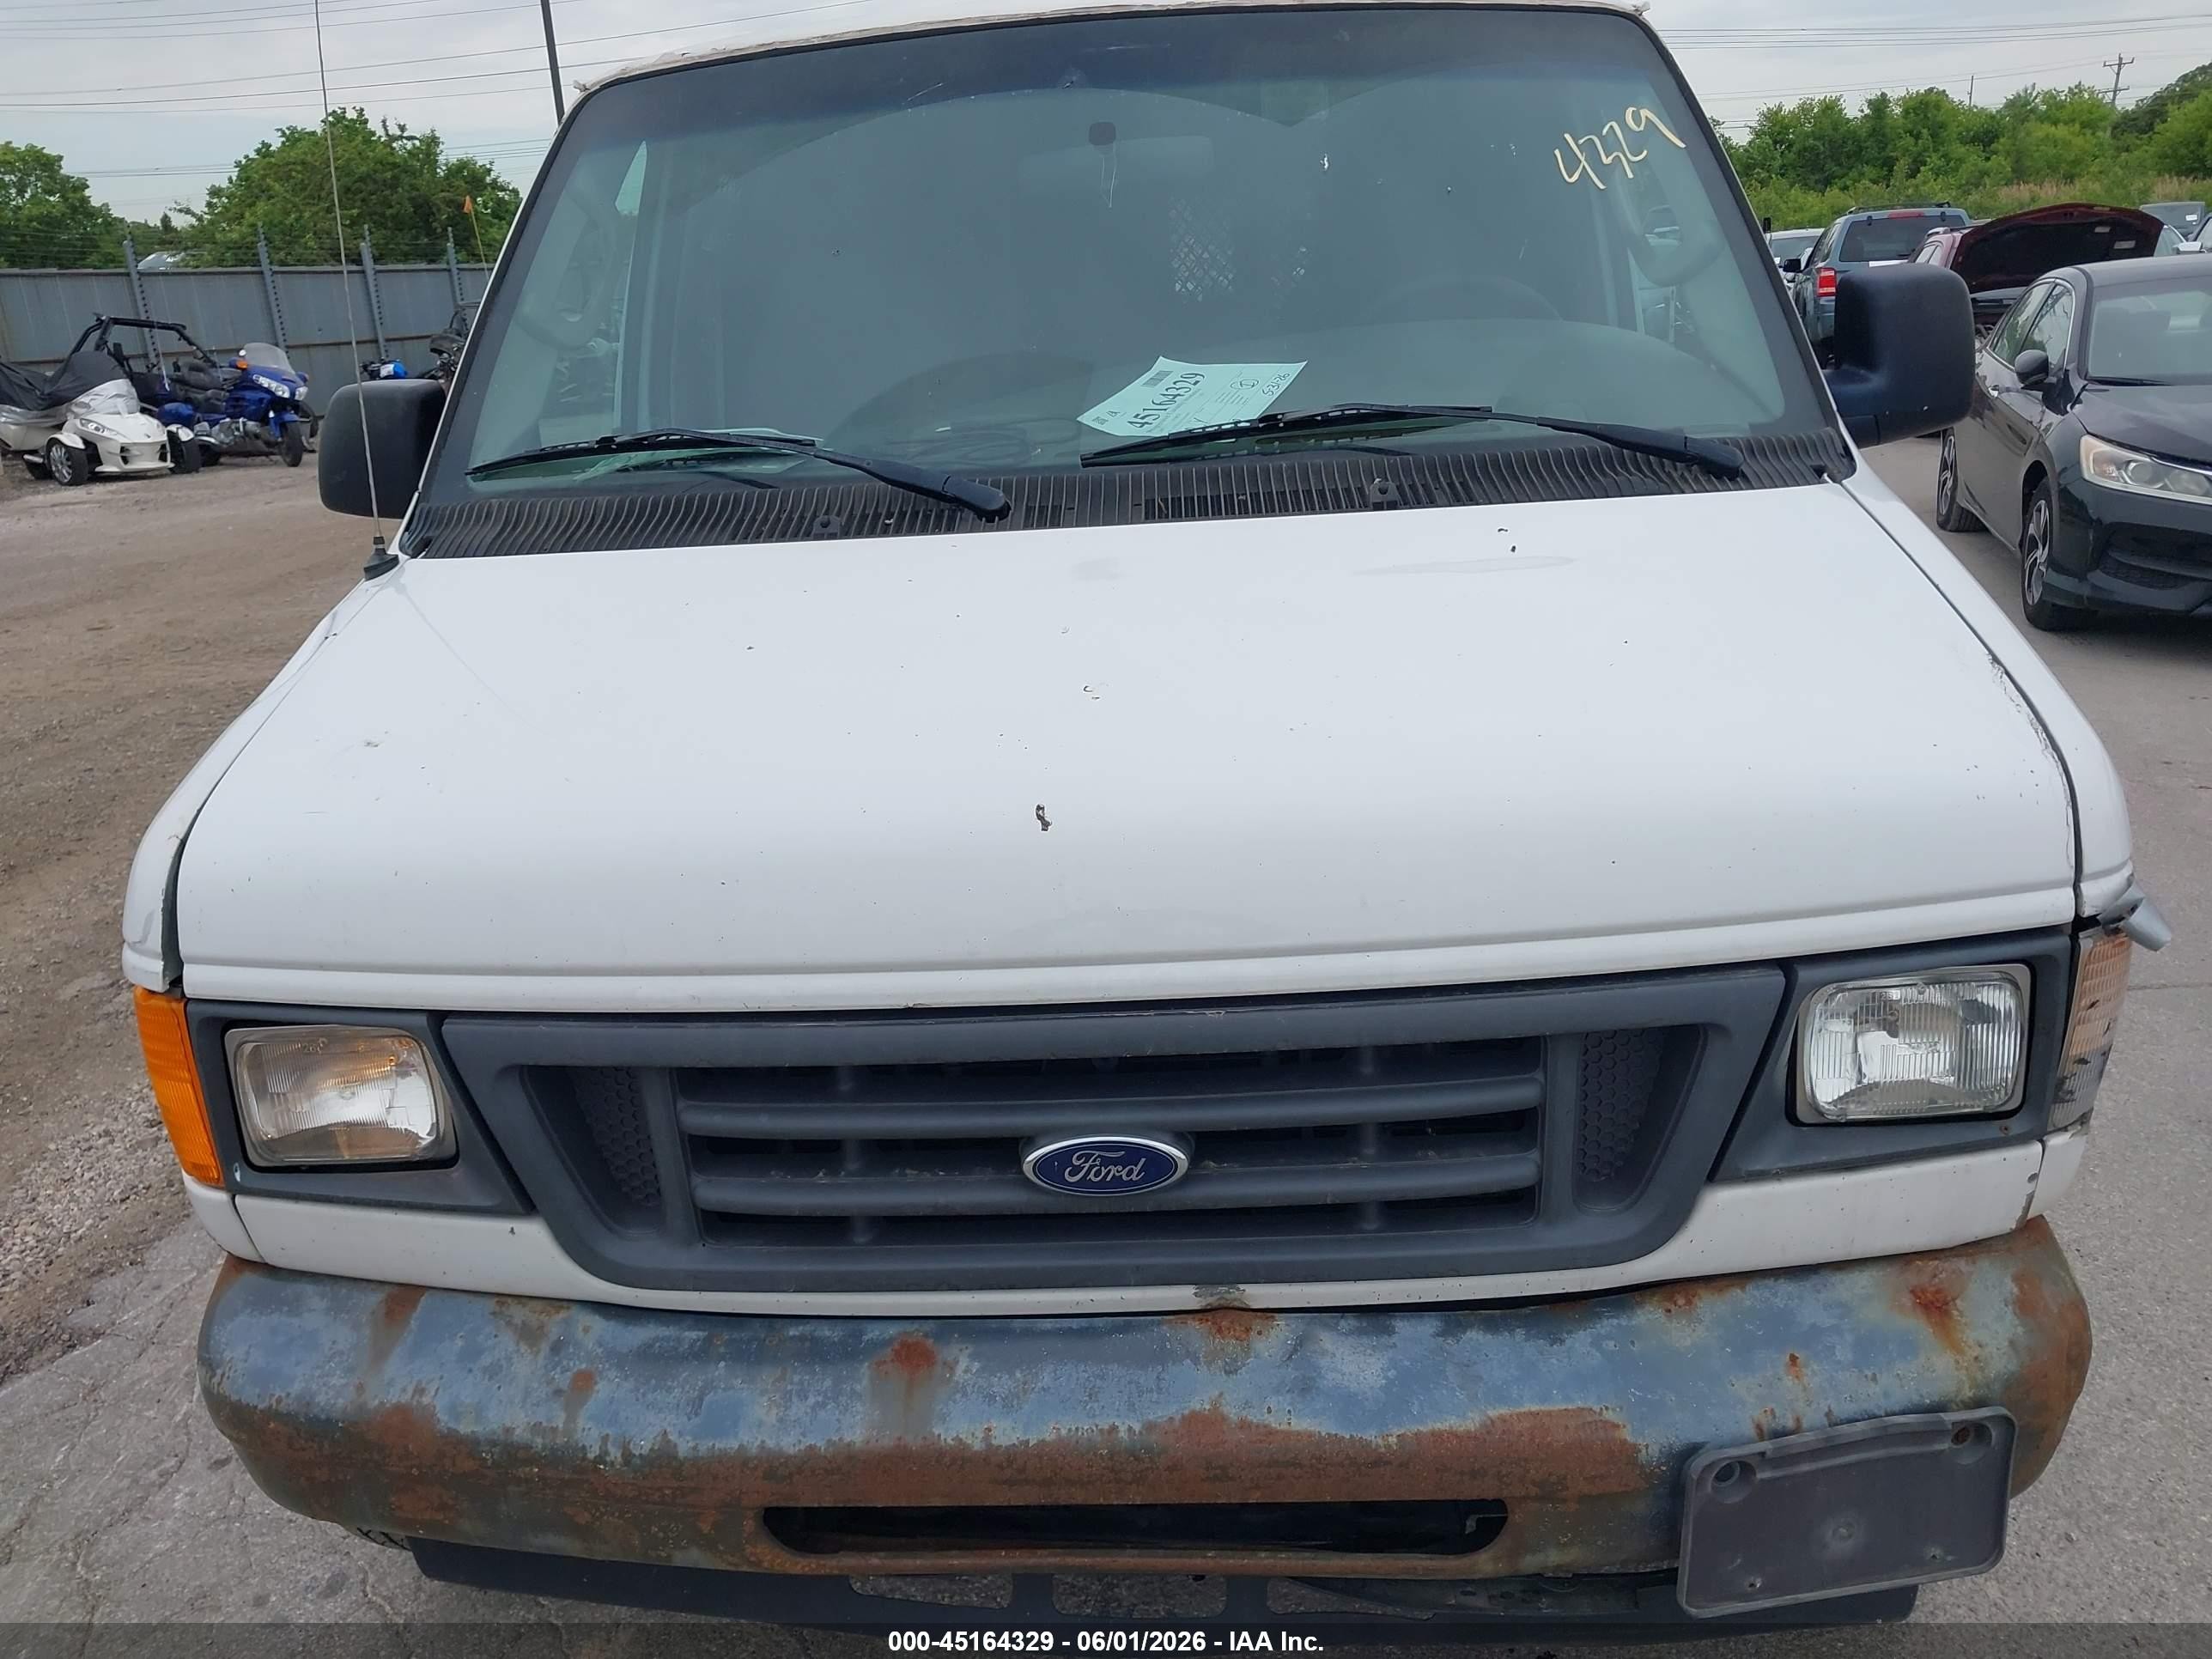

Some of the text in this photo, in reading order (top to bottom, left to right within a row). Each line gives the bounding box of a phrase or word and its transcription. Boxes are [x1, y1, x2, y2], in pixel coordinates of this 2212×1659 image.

[1554, 106, 1686, 190] 4329
[1127, 372, 1206, 429] 45164329
[1064, 1150, 1147, 1182] Ford
